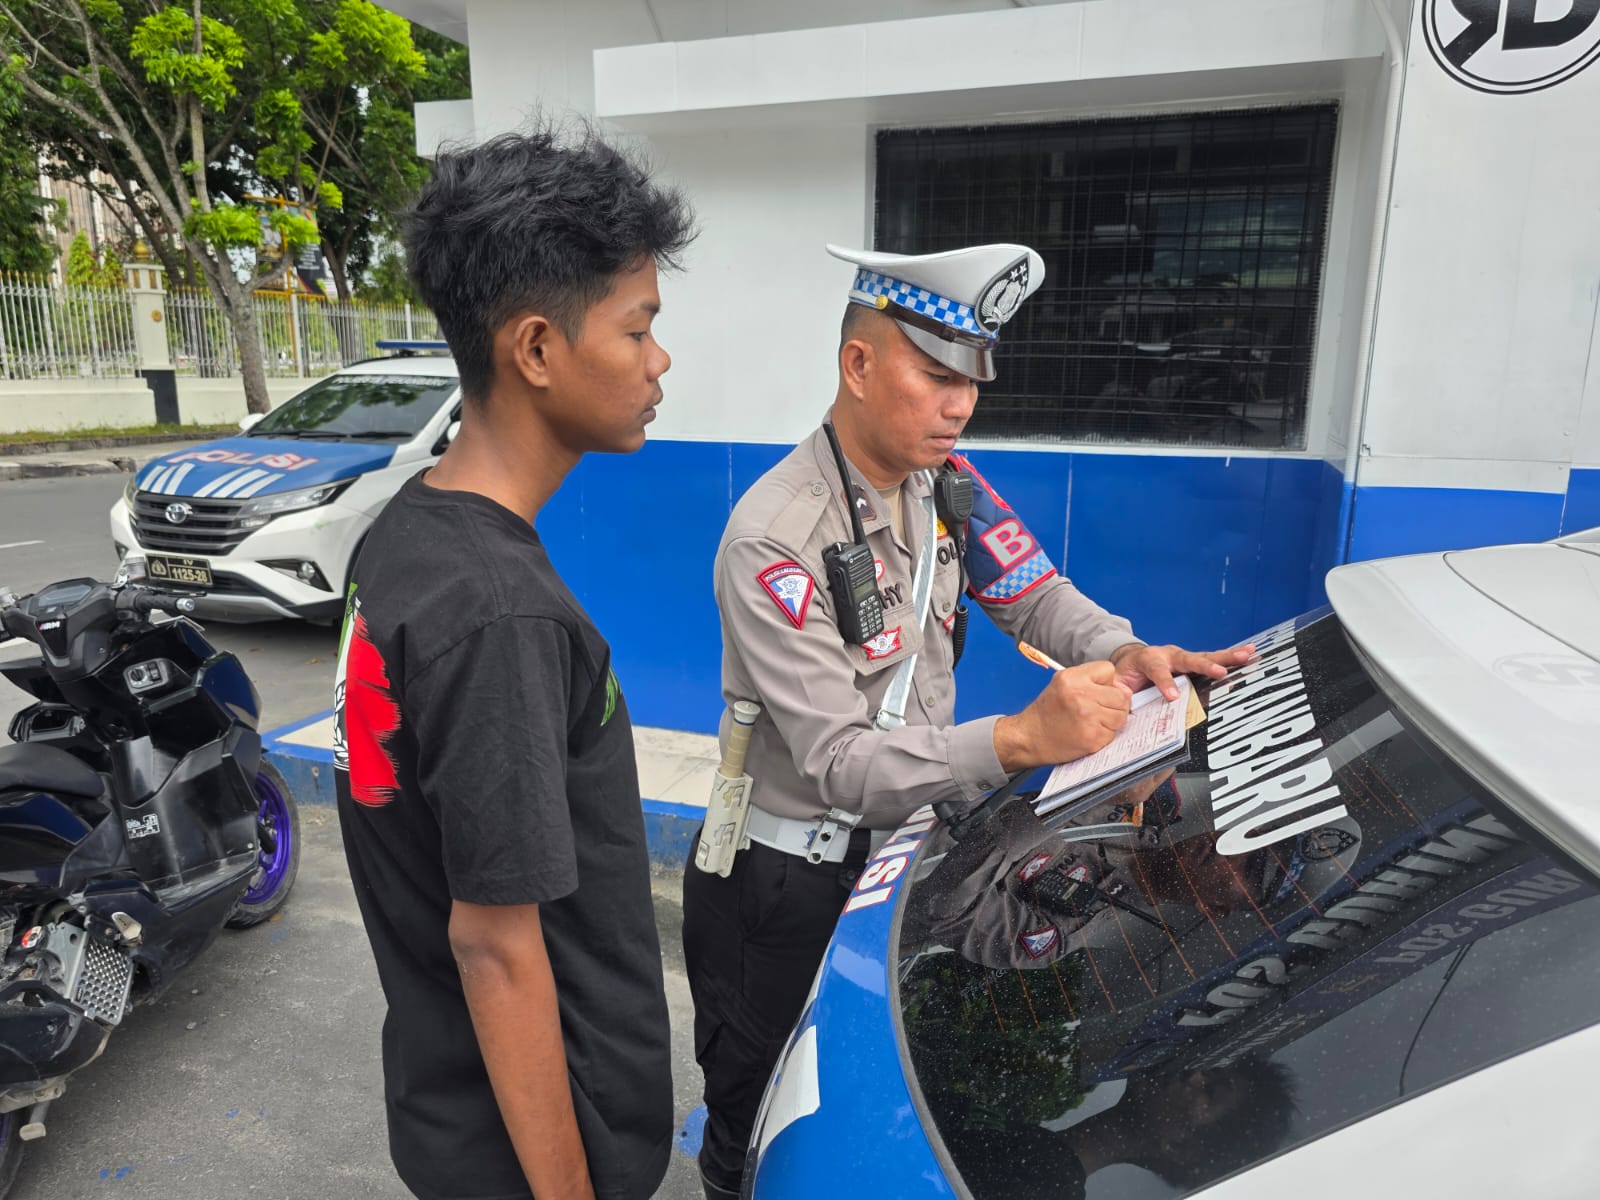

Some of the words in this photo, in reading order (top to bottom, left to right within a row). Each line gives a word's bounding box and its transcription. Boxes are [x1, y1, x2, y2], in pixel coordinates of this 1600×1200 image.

[167, 450, 319, 471] POLISI
[981, 519, 1034, 569] B
[1206, 645, 1348, 856] PEKANBARU
